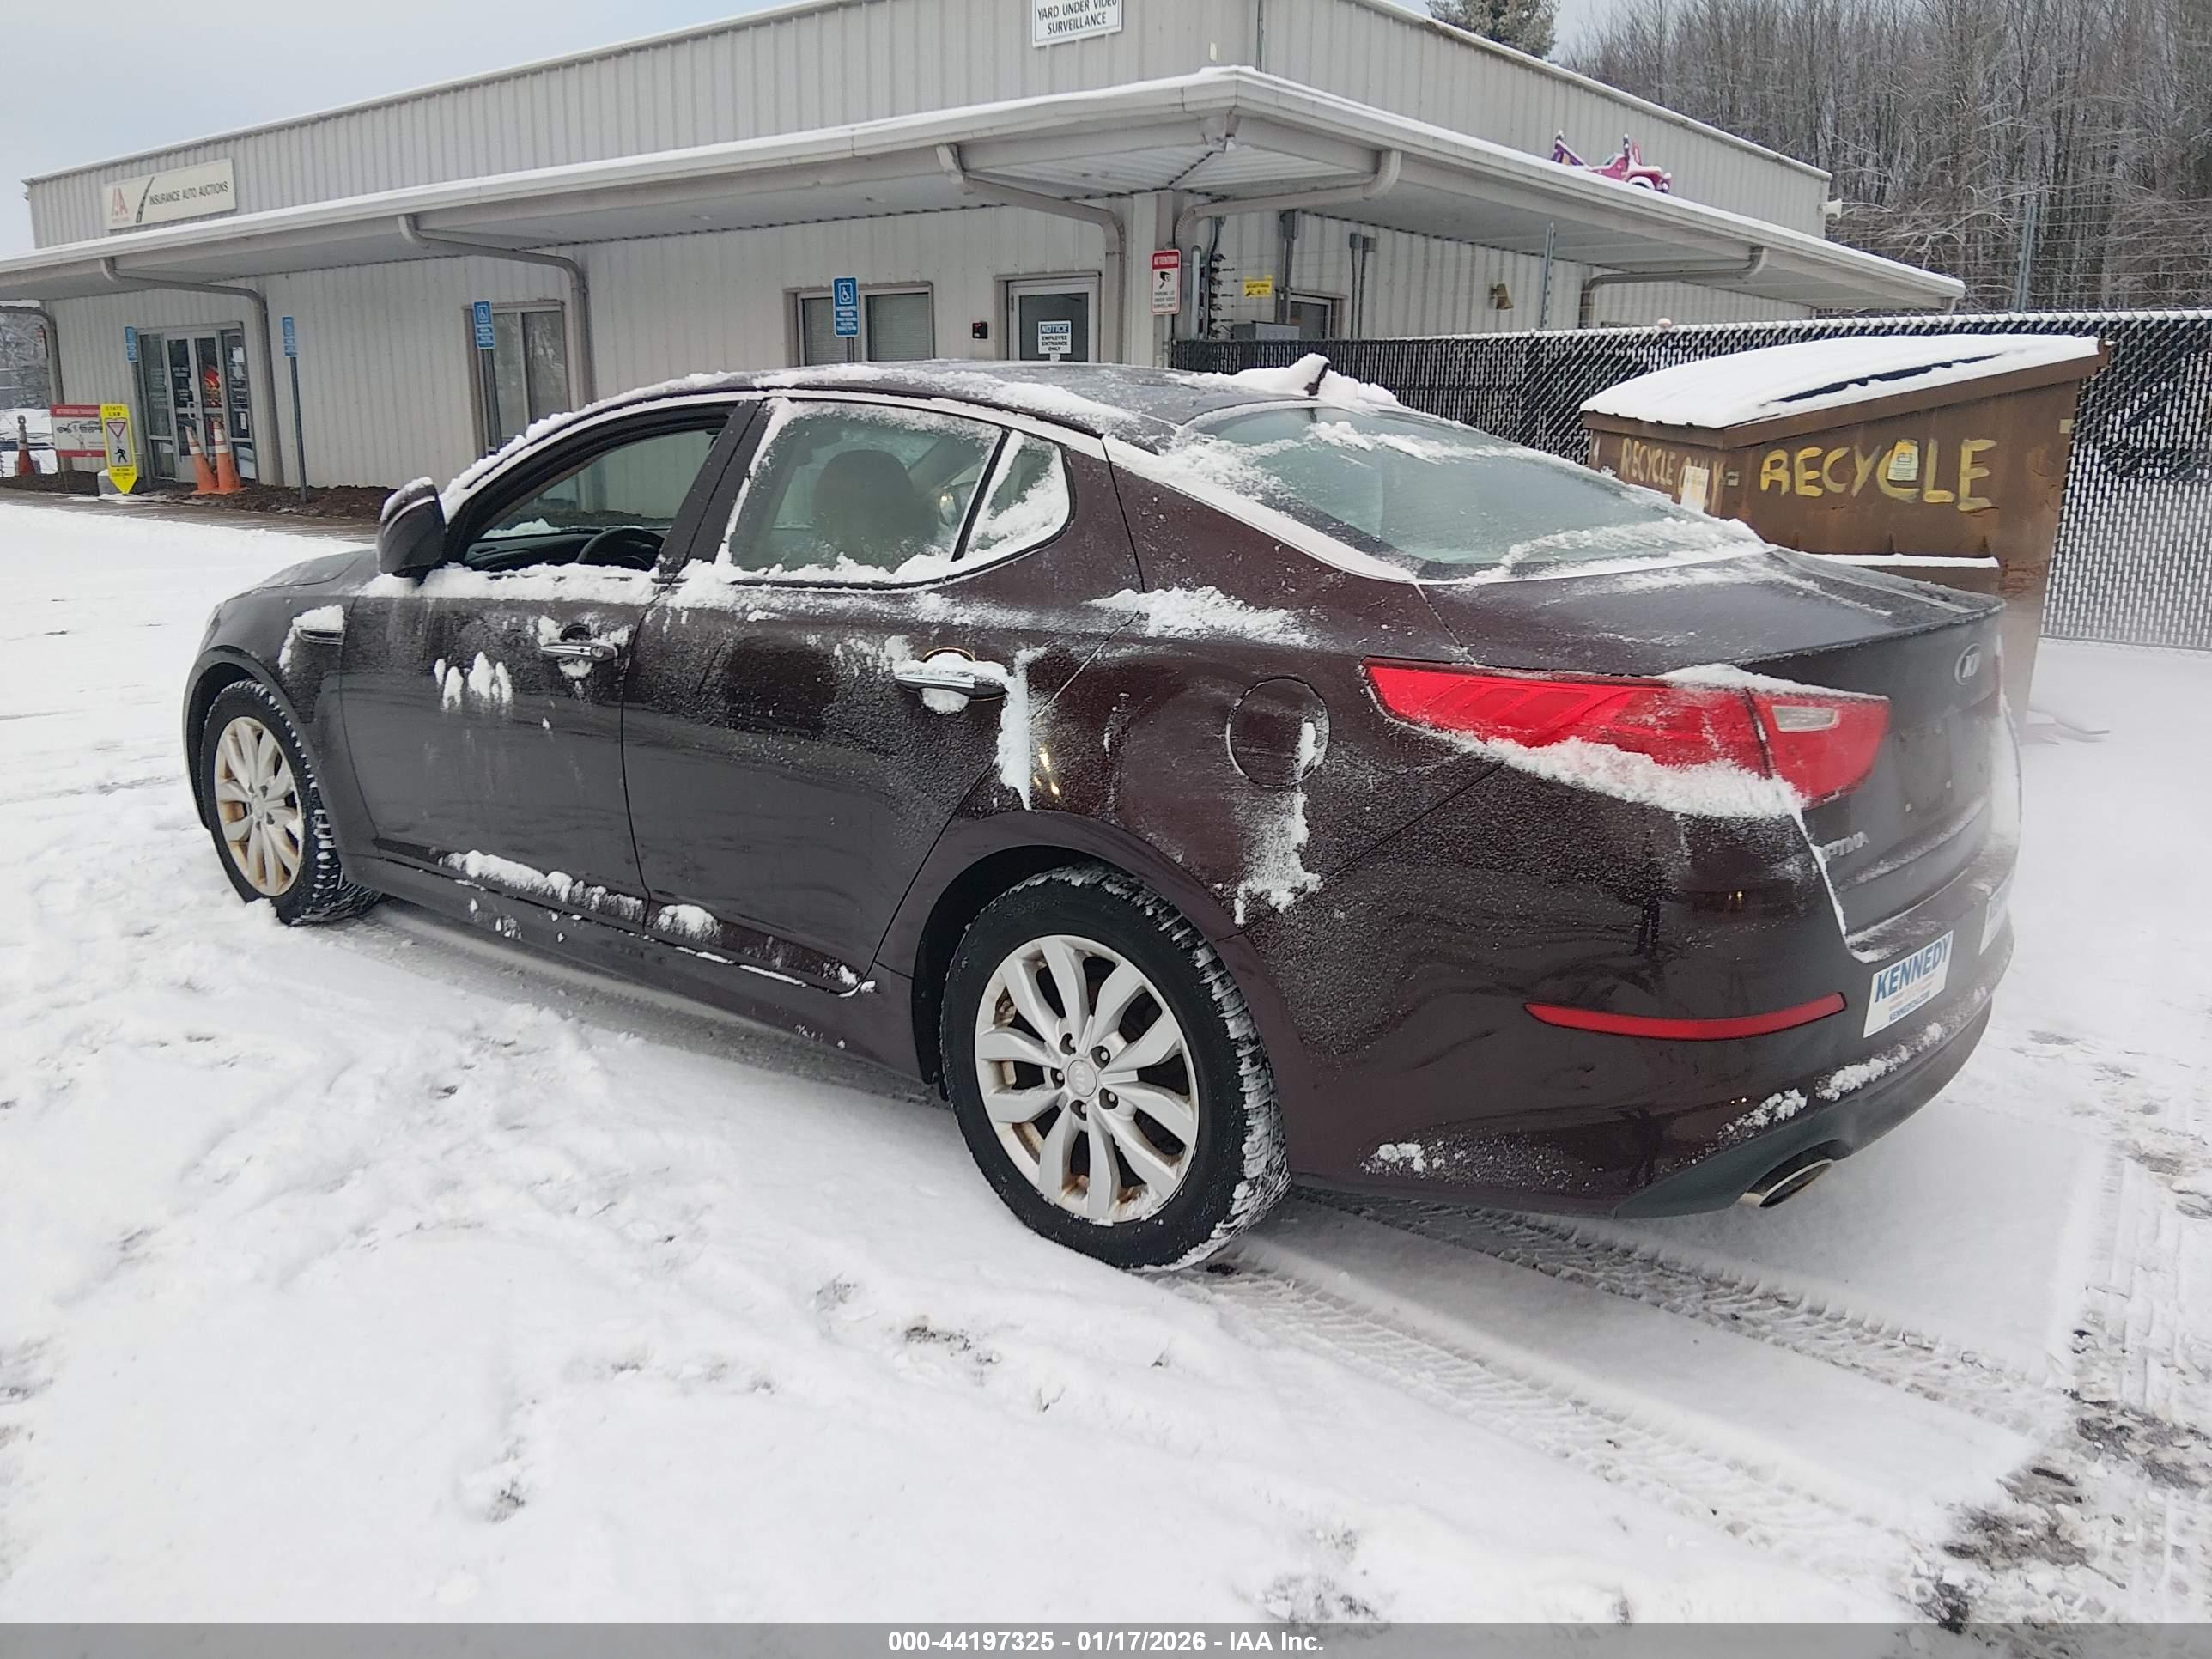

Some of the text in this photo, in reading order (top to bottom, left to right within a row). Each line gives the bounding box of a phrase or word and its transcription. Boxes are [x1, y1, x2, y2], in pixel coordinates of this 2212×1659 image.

[1037, 0, 1117, 21] YARD UNDER VIDEO
[1048, 12, 1107, 34] SURVEILLANCE
[149, 180, 228, 206] INSURANCE AUTO AUCTIONS
[1041, 325, 1069, 333] NOTICE
[1620, 437, 1676, 486] RECYCLE
[1760, 438, 1997, 512] RECYCLE
[1875, 933, 1951, 1004] KENNEDY
